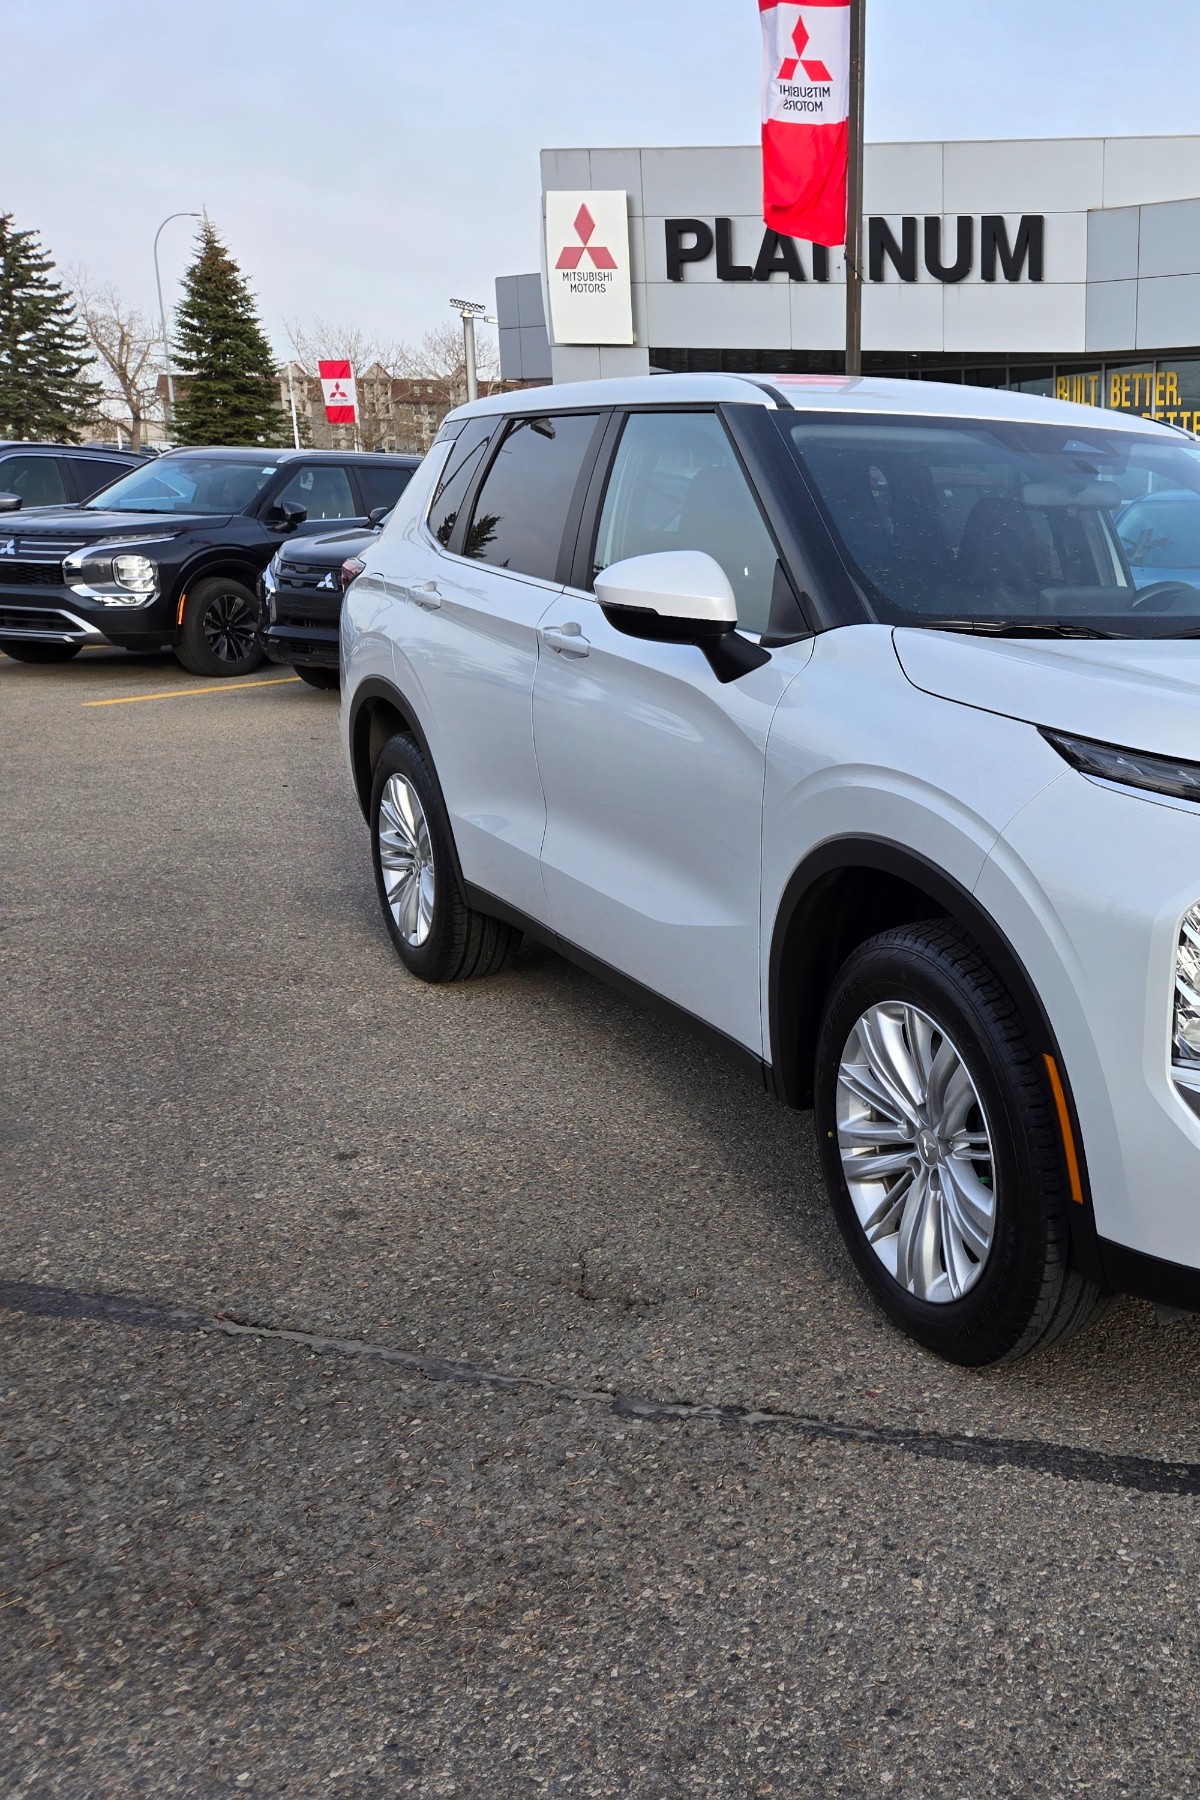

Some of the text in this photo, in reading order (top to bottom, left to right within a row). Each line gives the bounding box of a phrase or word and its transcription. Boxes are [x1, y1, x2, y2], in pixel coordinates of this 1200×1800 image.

[664, 214, 1045, 283] PLANUM
[562, 271, 613, 282] MITSUBISHI
[570, 283, 606, 294] MOTORS
[1110, 371, 1182, 408] BETTER.
